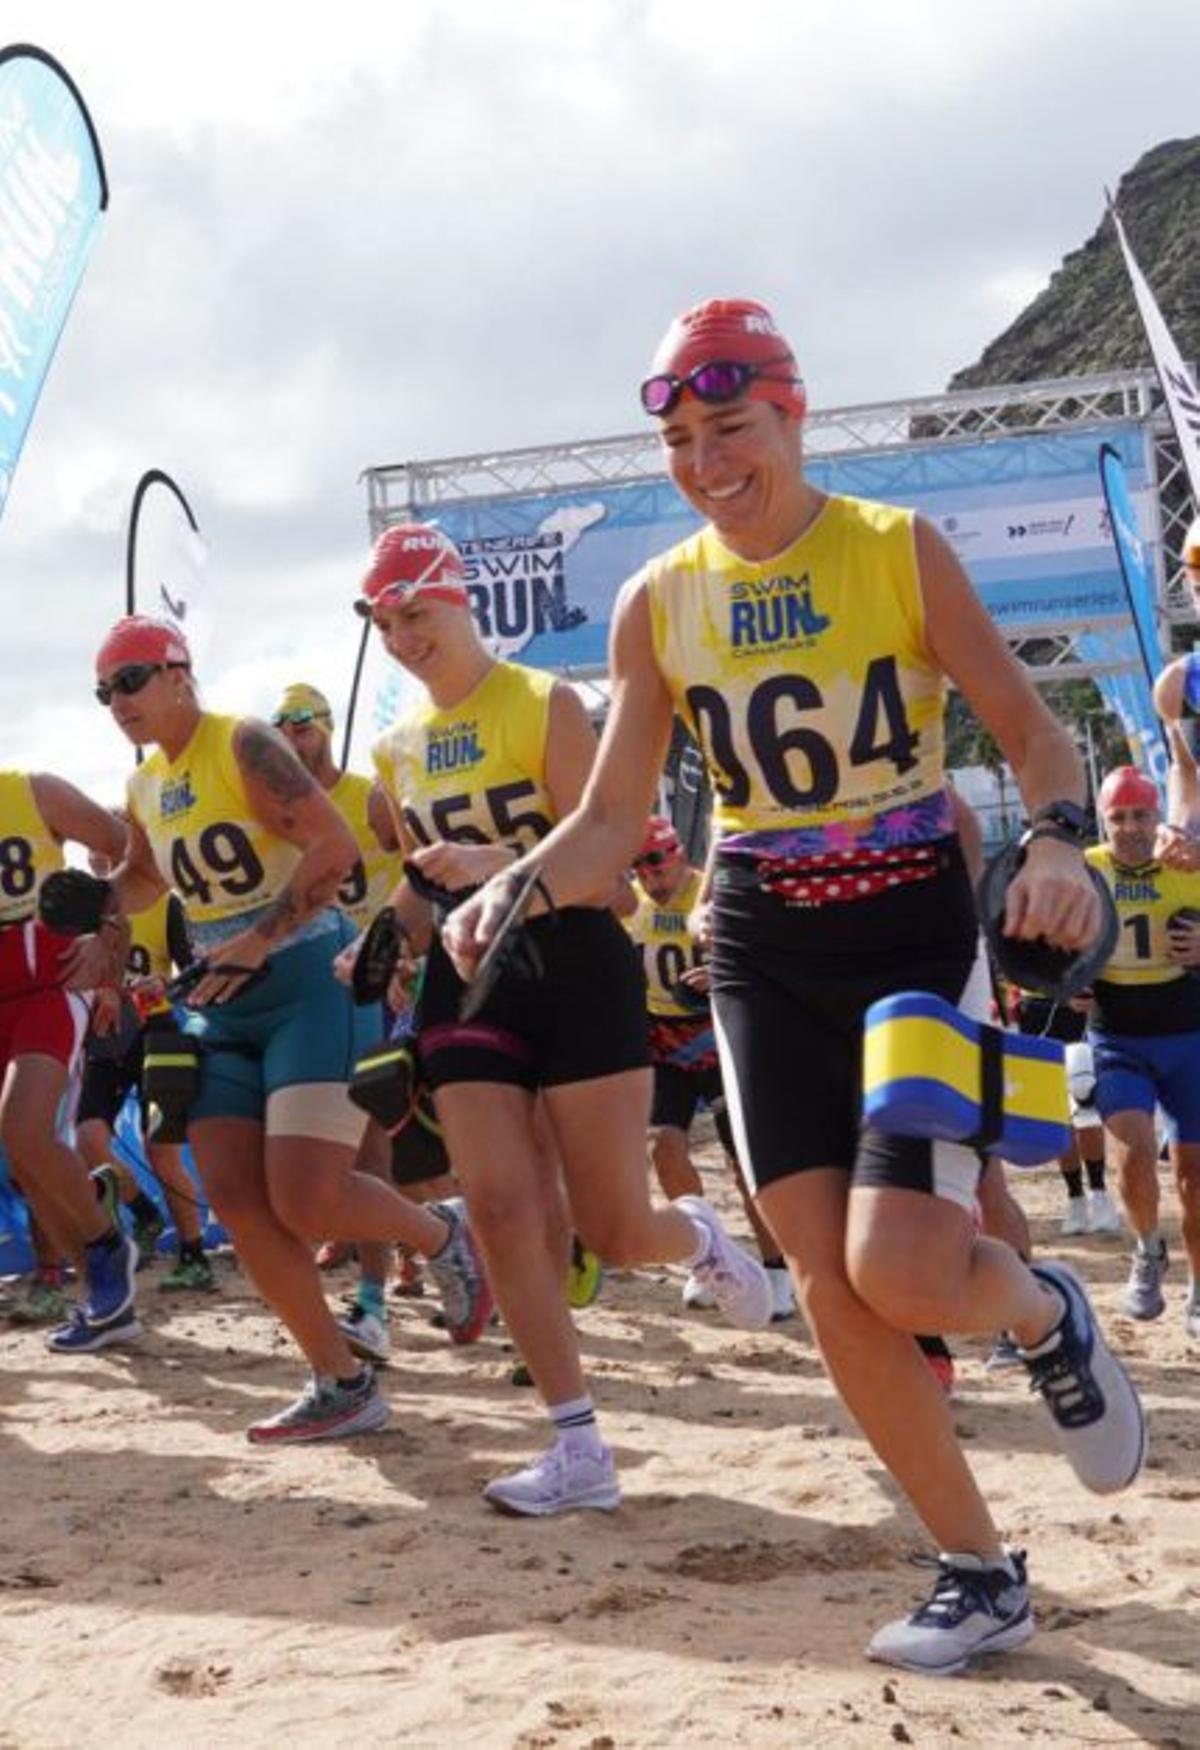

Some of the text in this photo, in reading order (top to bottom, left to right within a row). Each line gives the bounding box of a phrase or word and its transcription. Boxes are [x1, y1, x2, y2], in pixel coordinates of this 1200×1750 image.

[463, 550, 564, 580] SWIM
[730, 571, 811, 600] SWIM
[467, 574, 570, 638] RUN
[731, 590, 824, 647] RUN
[426, 734, 482, 772] RUN
[403, 779, 554, 858] 55
[171, 821, 265, 904] 49
